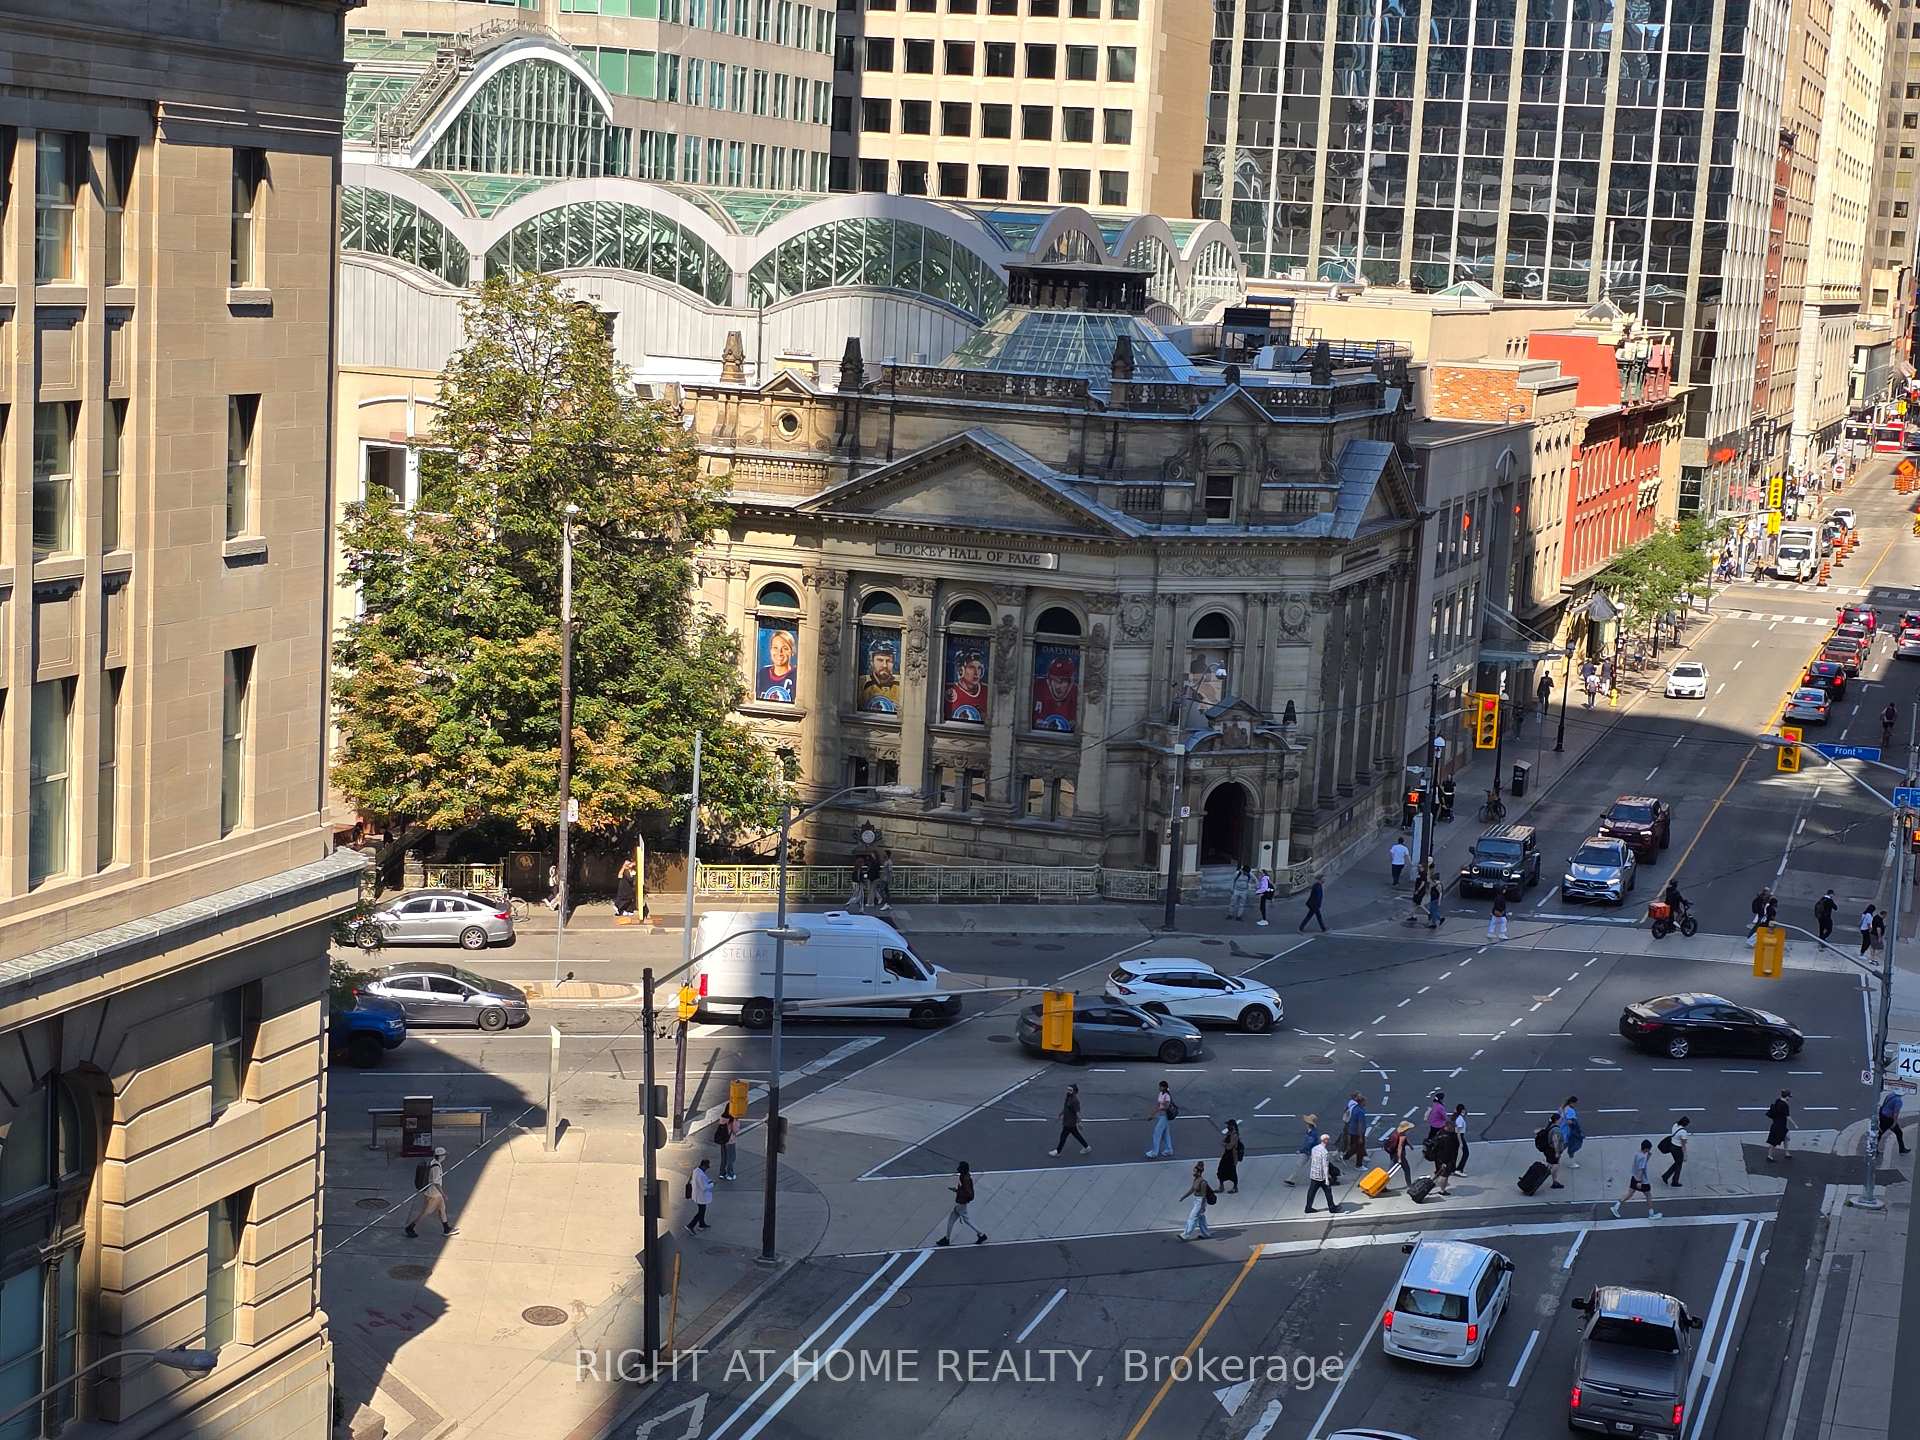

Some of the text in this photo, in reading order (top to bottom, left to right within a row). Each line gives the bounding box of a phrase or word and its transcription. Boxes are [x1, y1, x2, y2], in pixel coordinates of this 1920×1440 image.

[894, 543, 1041, 565] HOCKEY HALL OF FAME
[1834, 747, 1856, 756] Front
[721, 947, 769, 960] STELLAR
